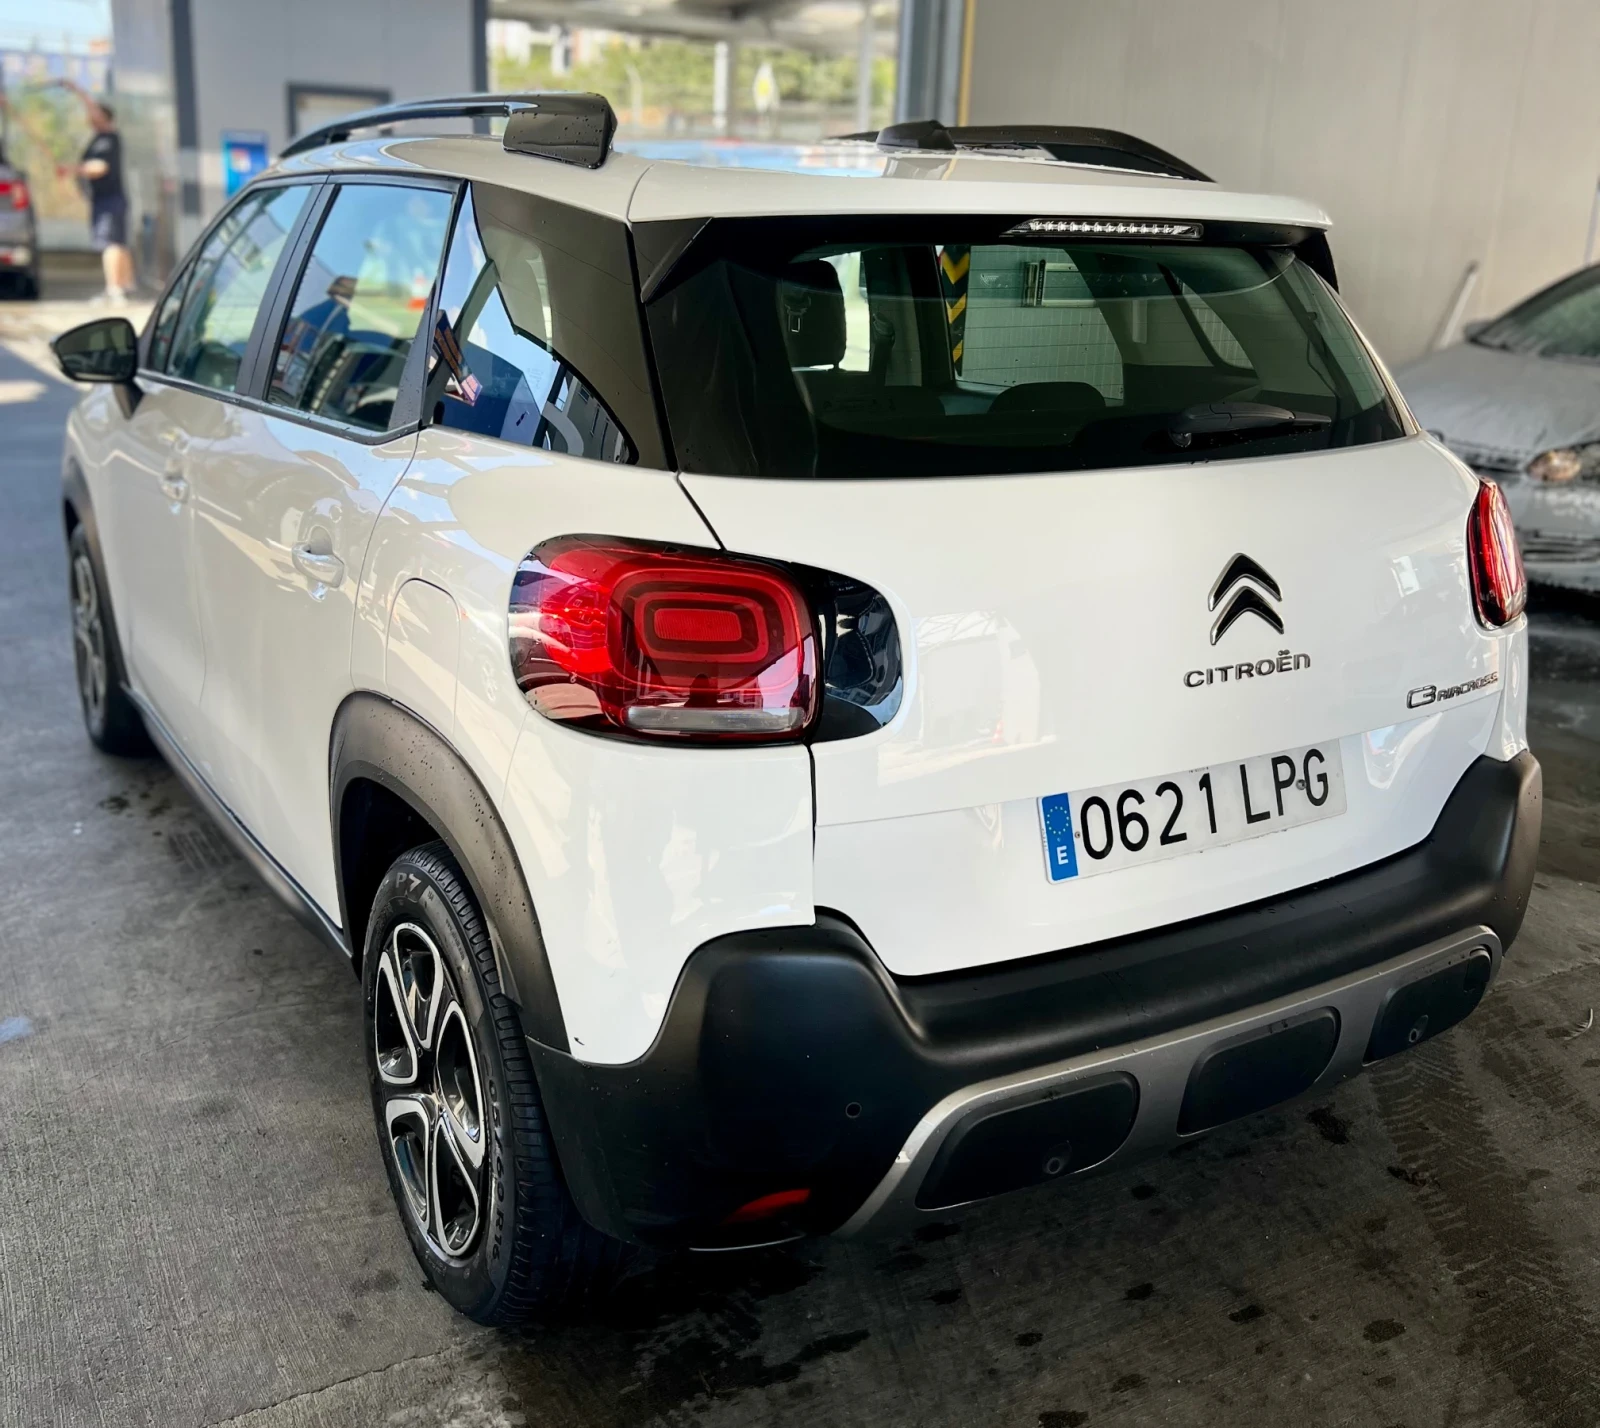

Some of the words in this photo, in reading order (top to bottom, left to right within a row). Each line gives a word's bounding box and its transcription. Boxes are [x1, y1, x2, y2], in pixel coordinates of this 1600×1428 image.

[1406, 684, 1437, 709] C3
[1437, 671, 1498, 701] AIRCROSS
[1080, 772, 1218, 860] 0621
[1240, 748, 1329, 824] LPG
[1057, 845, 1069, 865] E
